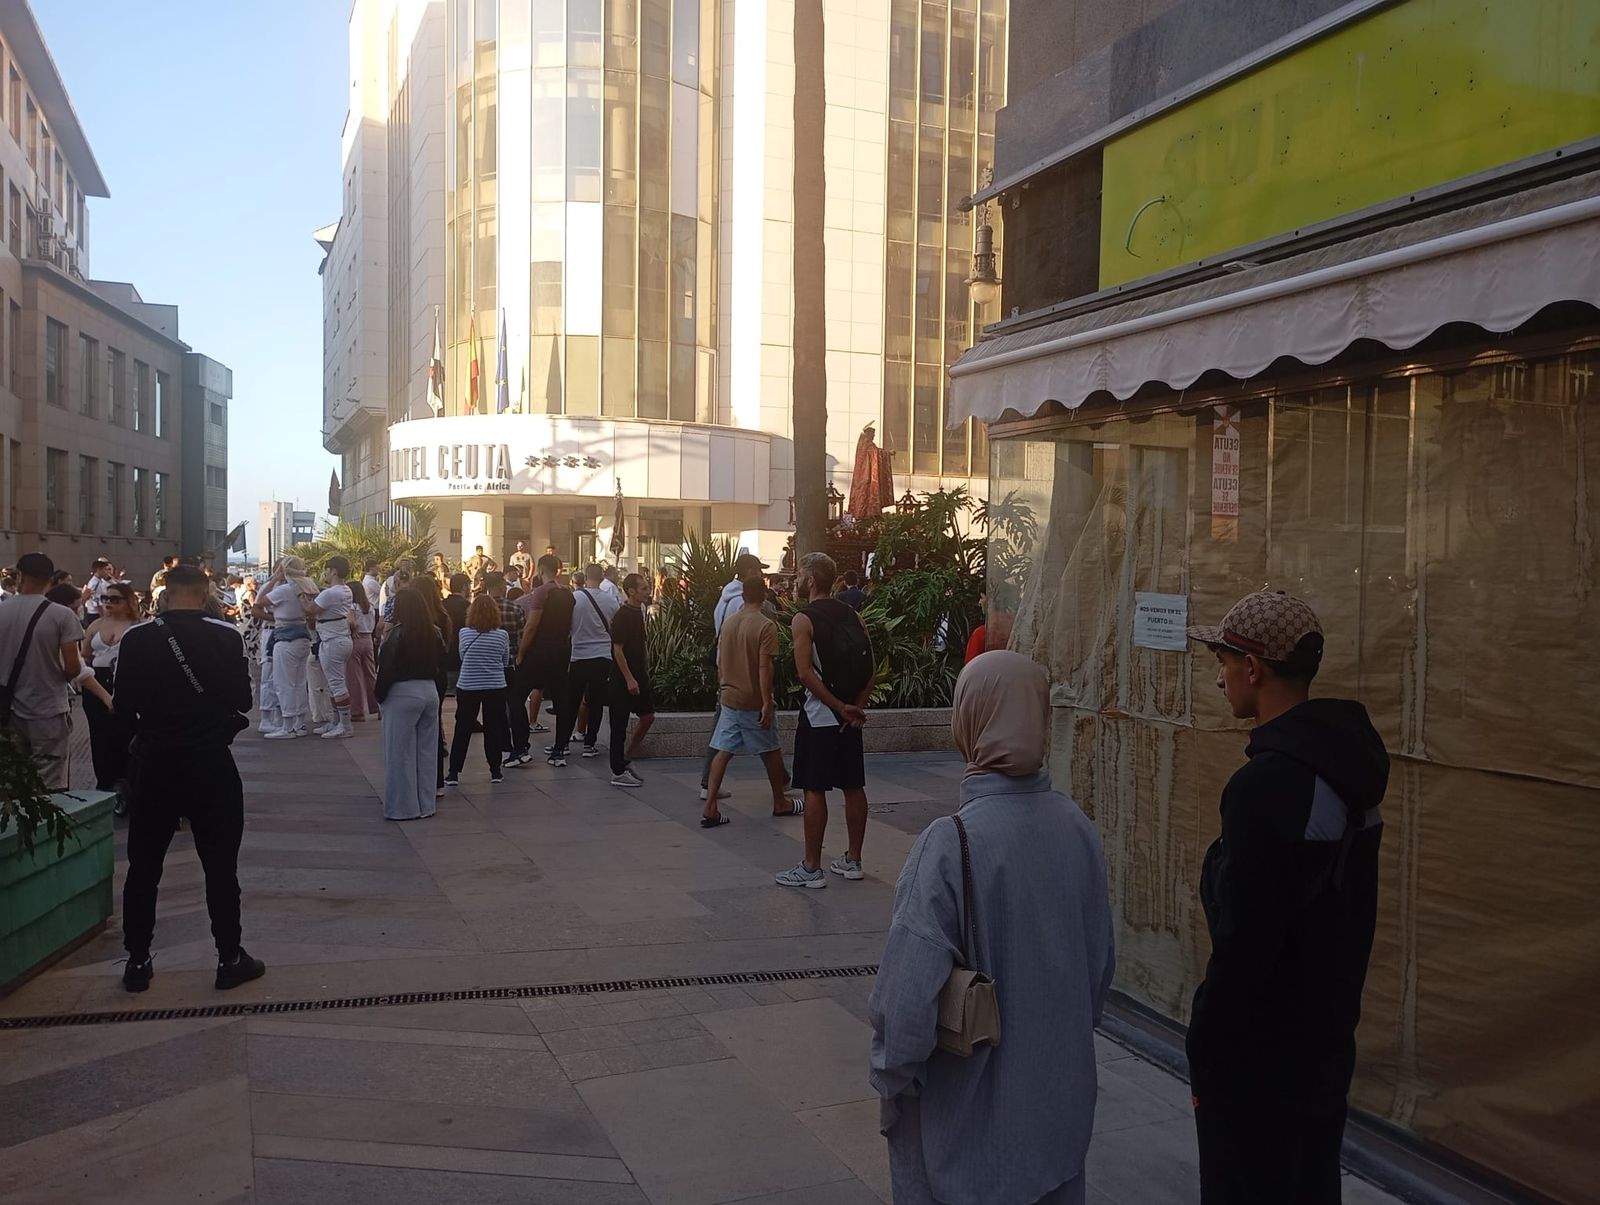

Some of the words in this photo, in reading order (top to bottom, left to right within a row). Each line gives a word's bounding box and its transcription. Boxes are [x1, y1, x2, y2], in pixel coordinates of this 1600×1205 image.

[438, 444, 513, 480] CEUTA
[1147, 616, 1167, 624] PUERTO
[168, 637, 186, 663] UNDER
[181, 663, 205, 694] ARMOUR
